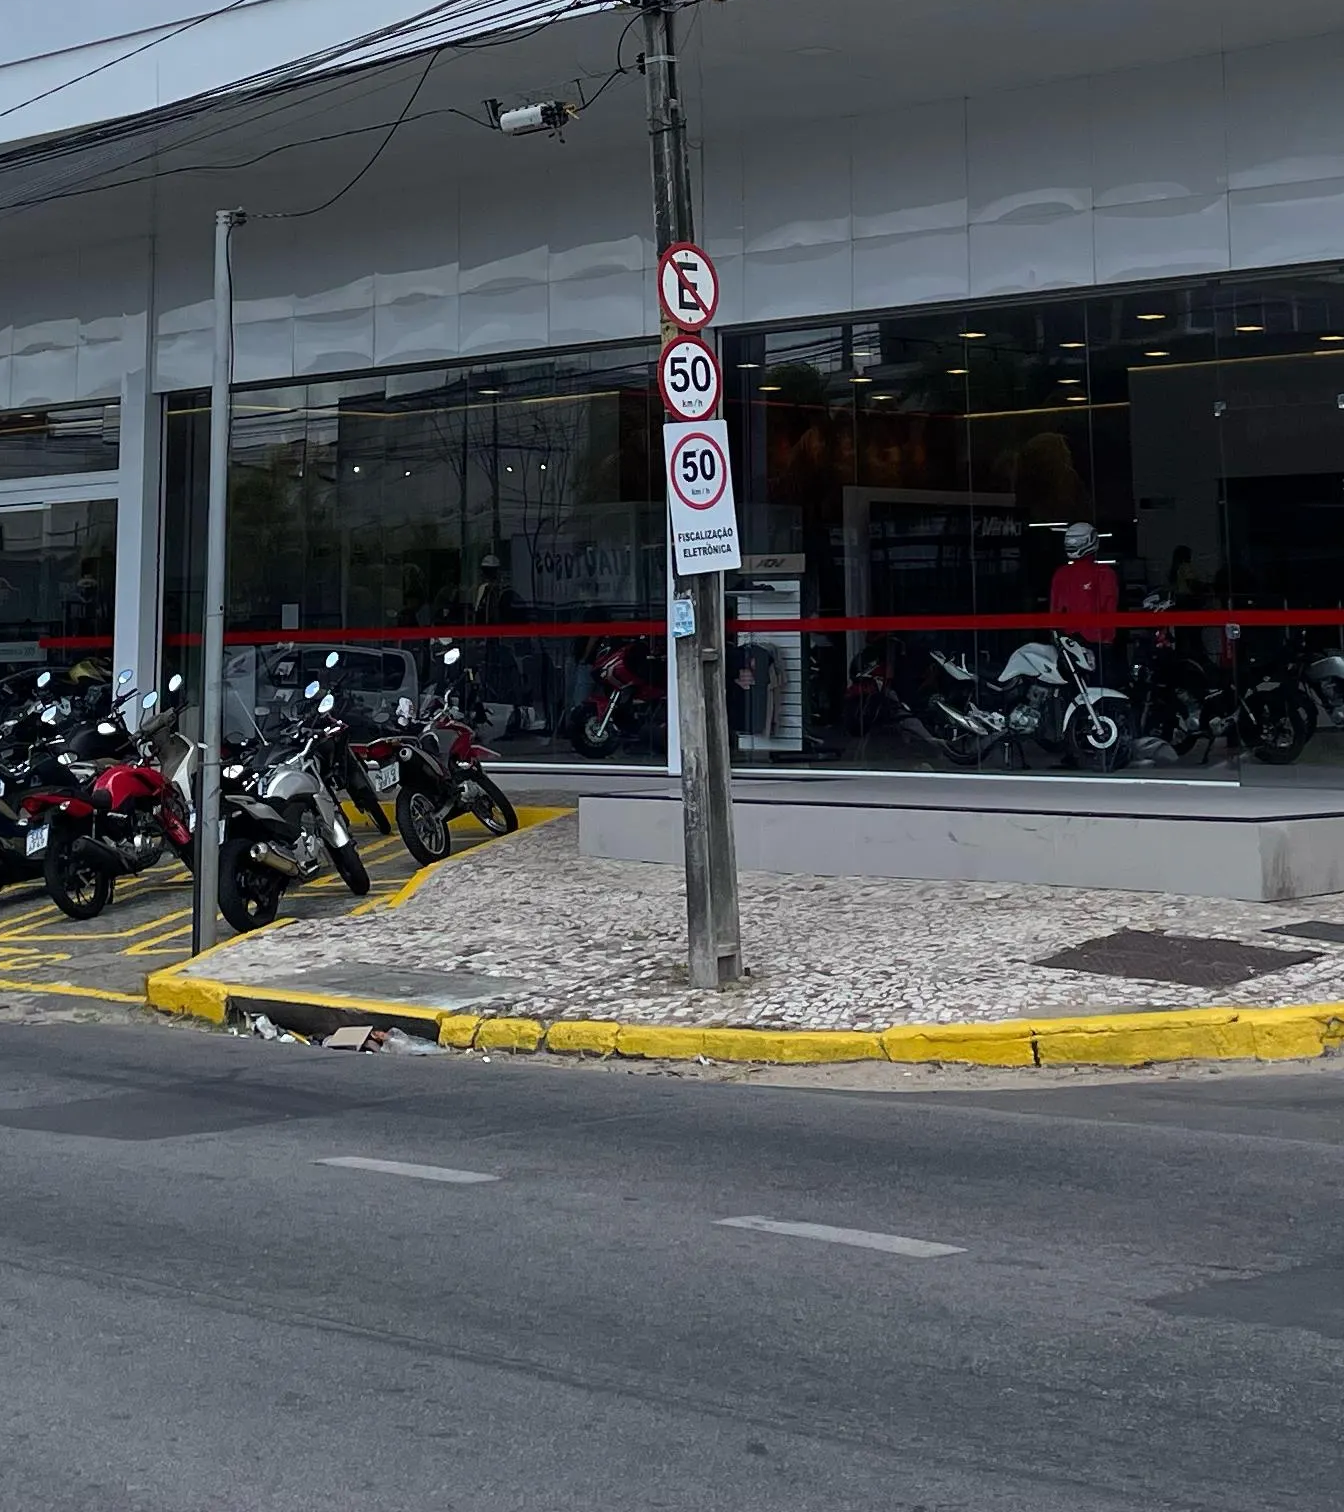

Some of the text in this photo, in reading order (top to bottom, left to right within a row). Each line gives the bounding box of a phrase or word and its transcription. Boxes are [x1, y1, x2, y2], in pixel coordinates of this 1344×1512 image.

[678, 261, 701, 311] E
[670, 355, 711, 392] 50
[681, 398, 703, 408] km/h
[682, 448, 716, 483] 50
[677, 526, 734, 543] FISCALIZAÇÃO
[682, 542, 733, 559] ELETRÔNICA
